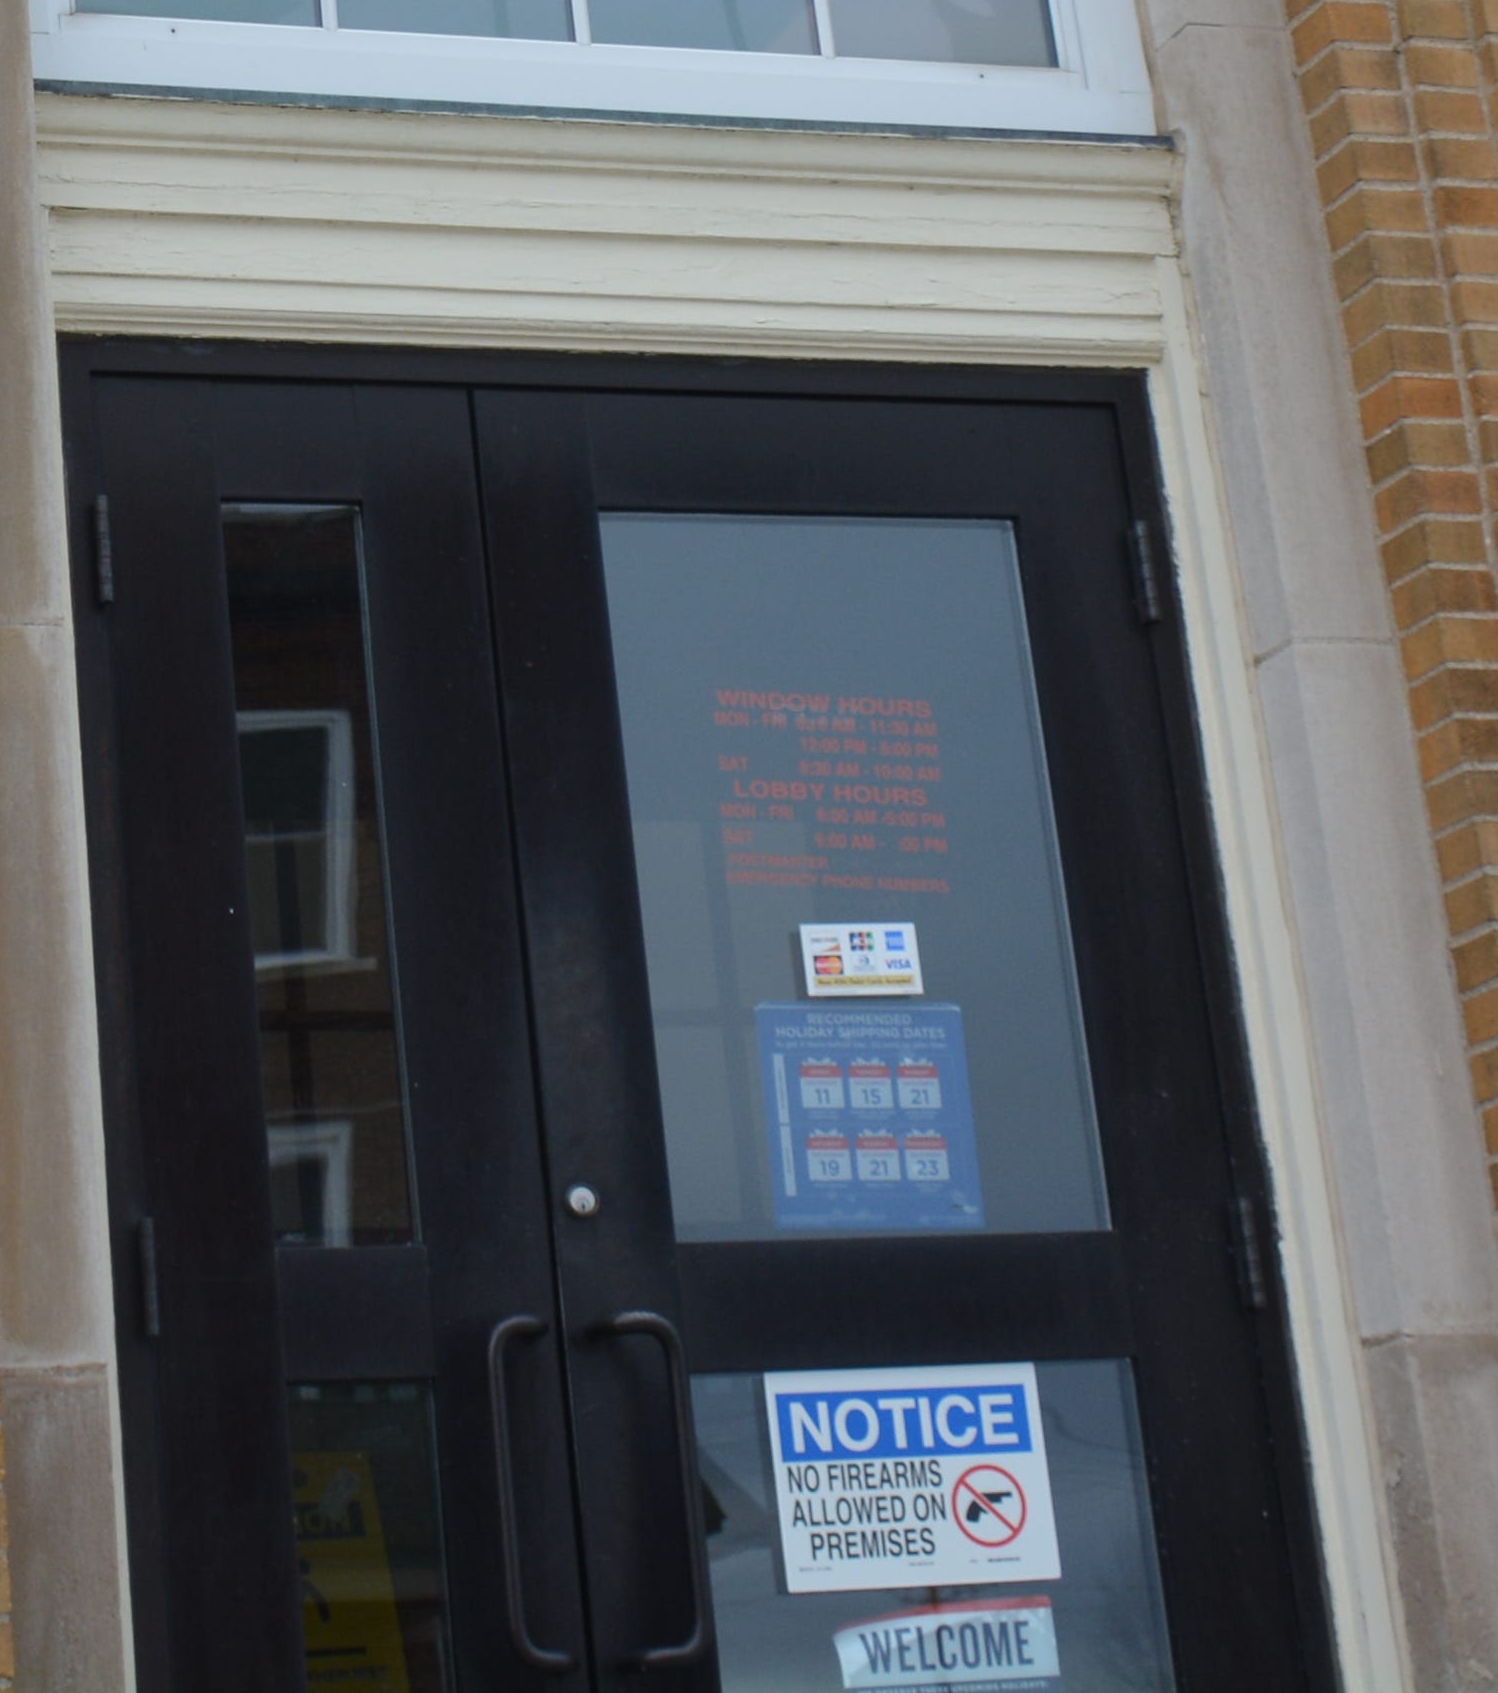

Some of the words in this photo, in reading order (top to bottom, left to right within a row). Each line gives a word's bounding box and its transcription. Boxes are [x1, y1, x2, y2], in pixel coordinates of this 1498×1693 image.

[716, 689, 830, 712] WINDOW
[838, 695, 933, 718] HOURS
[733, 780, 824, 801] LOBBY
[834, 784, 928, 807] HOURS
[885, 958, 912, 969] VISA
[805, 1012, 912, 1025] RECOMMENDED
[774, 1026, 833, 1039] HOLIDAY
[837, 1026, 901, 1040] SHIPPING
[903, 1027, 946, 1040] DATES
[814, 1088, 831, 1105] 11
[860, 1088, 882, 1106] 15
[910, 1088, 930, 1106] 21
[819, 1159, 840, 1177] 19
[870, 1159, 890, 1177] 21
[917, 1159, 939, 1177] 23
[789, 1393, 1019, 1454] NOTICE
[787, 1464, 820, 1494] NO
[827, 1459, 943, 1492] FIREARMS
[792, 1495, 906, 1528] ALLOWED
[913, 1492, 948, 1522] ON
[810, 1527, 936, 1561] PREMISES
[859, 1620, 1034, 1675] WELCOME
